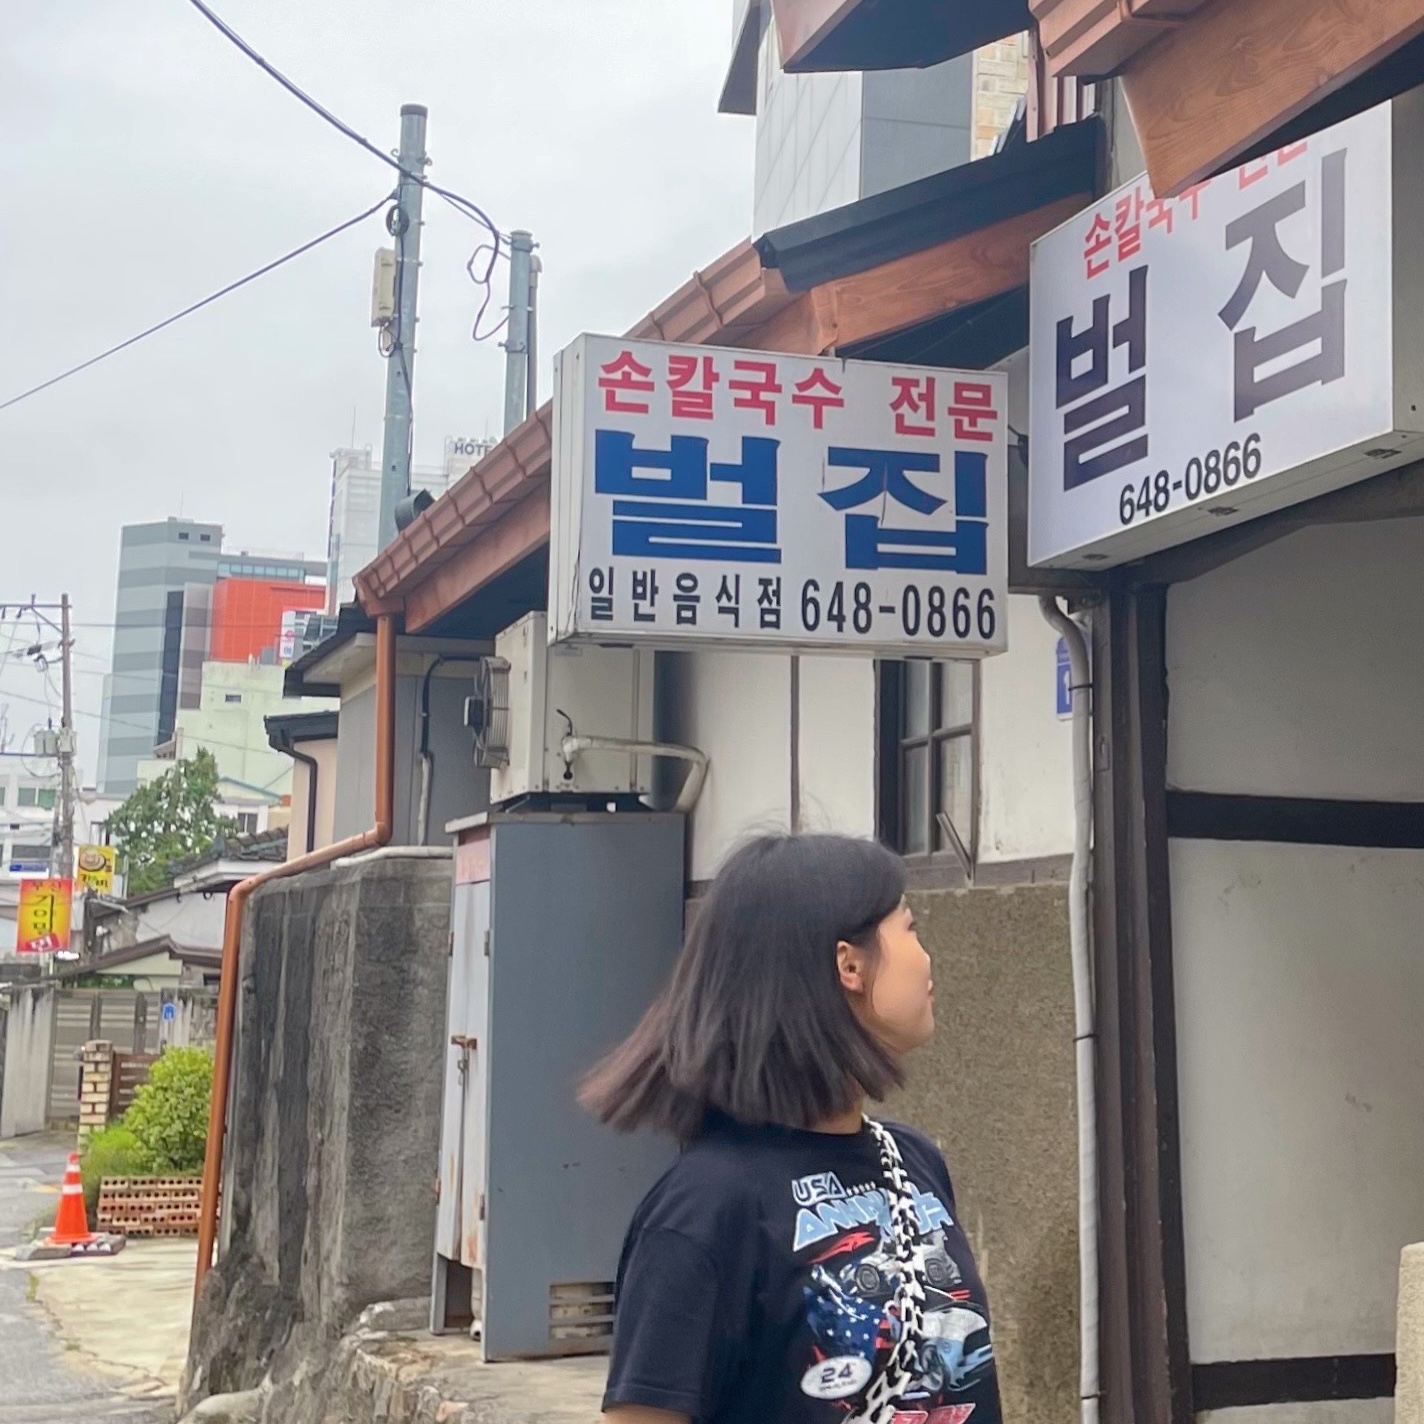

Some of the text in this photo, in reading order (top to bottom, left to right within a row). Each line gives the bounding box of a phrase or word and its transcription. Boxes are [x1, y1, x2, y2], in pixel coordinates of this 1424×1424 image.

[598, 350, 999, 442] 손칼국수 전문
[1119, 433, 1262, 526] 648-0866
[588, 566, 997, 640] 일반음식점 648-0866
[792, 1171, 847, 1206] USA
[820, 1362, 853, 1384] 24
